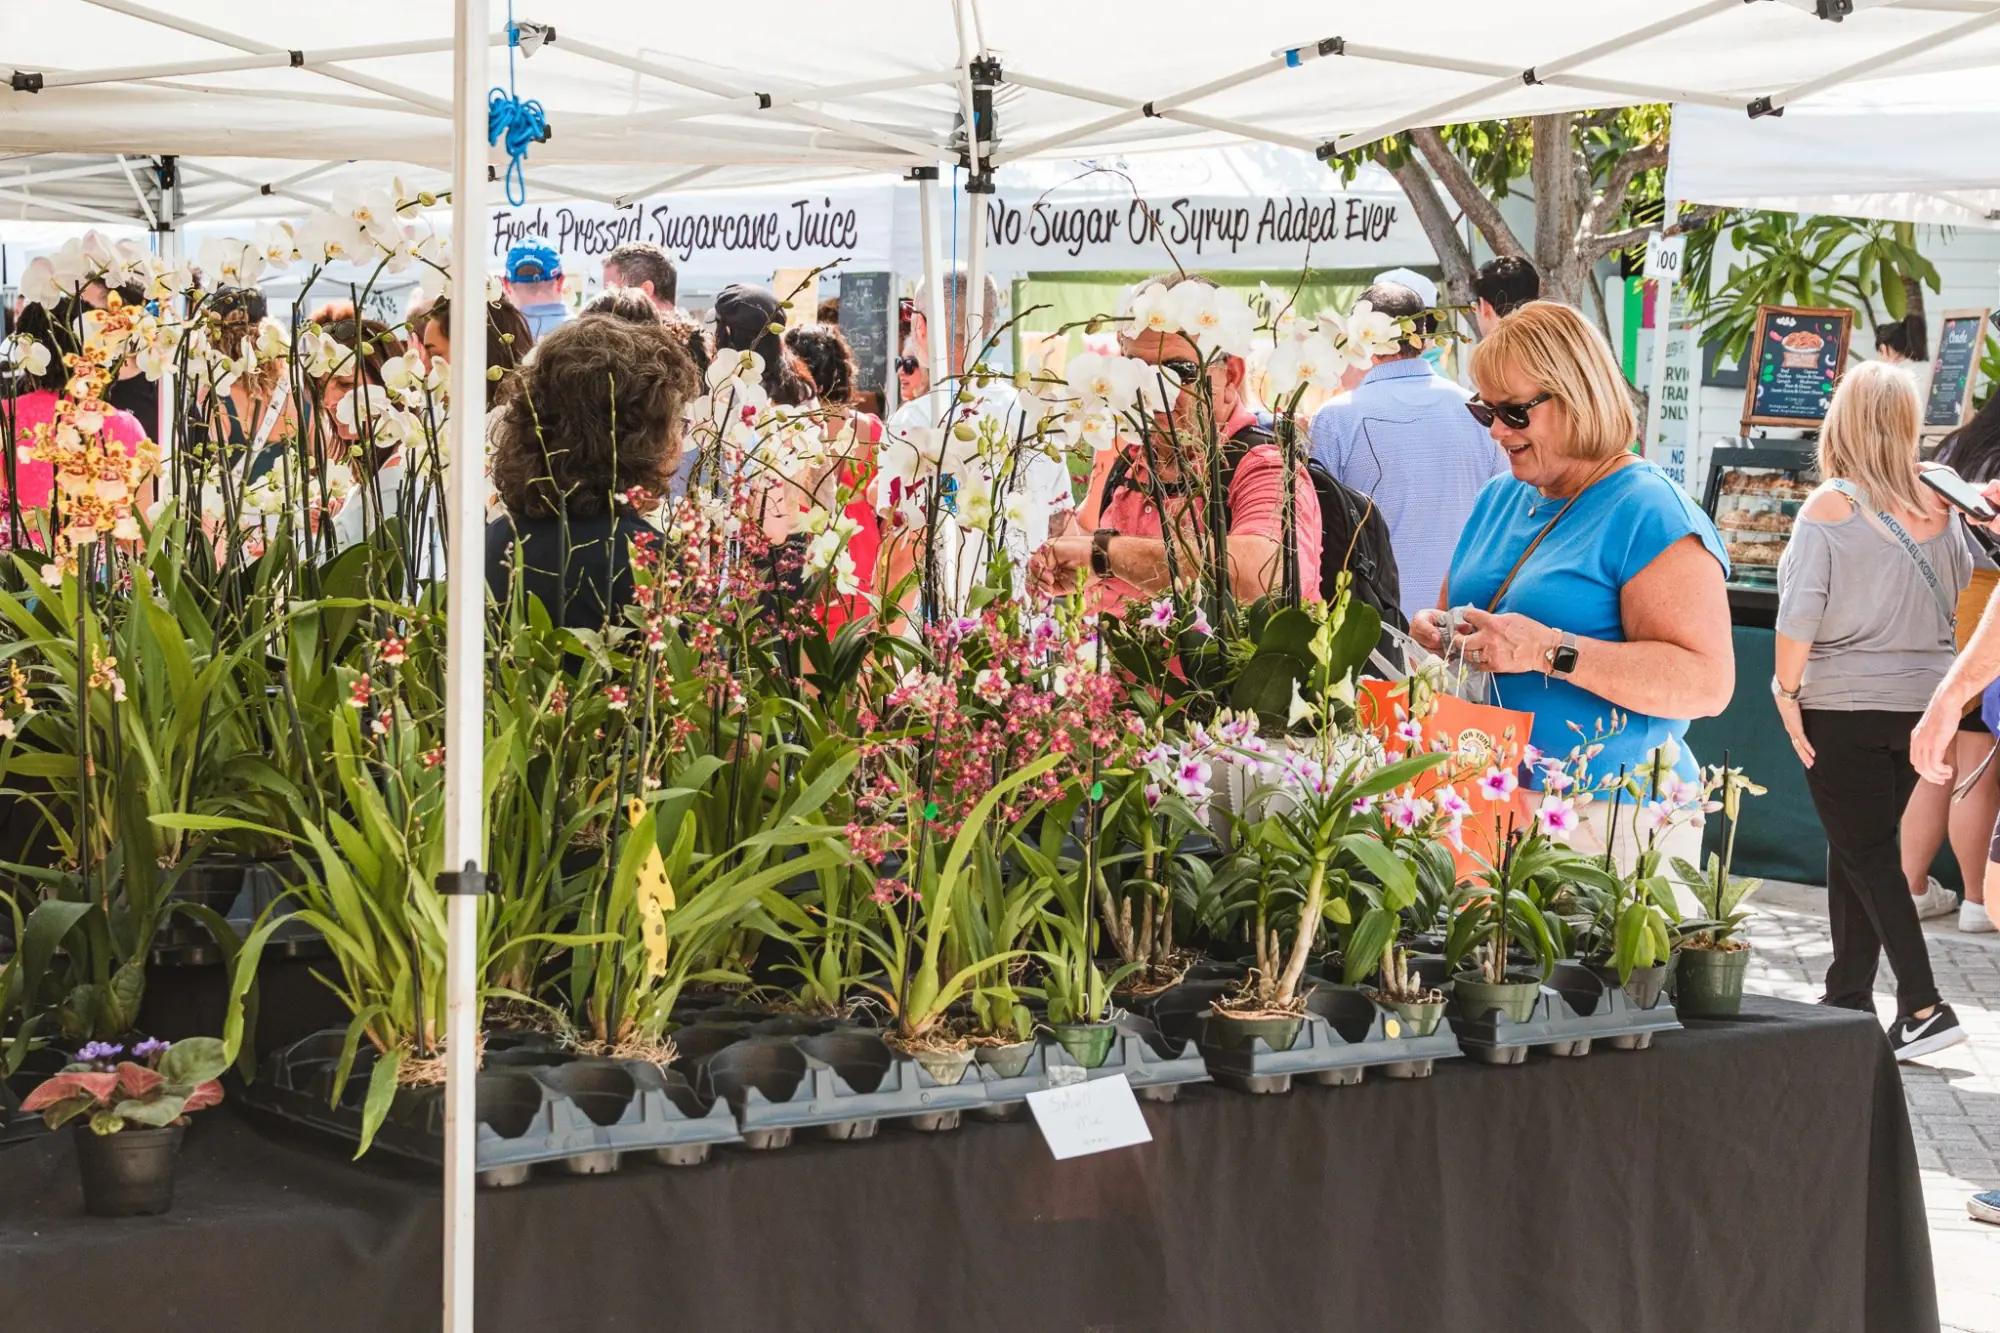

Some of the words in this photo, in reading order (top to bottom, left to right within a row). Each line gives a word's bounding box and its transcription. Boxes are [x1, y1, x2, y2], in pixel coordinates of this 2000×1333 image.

[493, 207, 549, 256] Fresh
[556, 204, 643, 255] Pressed
[649, 205, 780, 262] Sugarcane
[786, 197, 857, 250] Juice
[986, 198, 1021, 248] No
[1030, 202, 1121, 256] Sugar
[1128, 198, 1164, 245] Or
[1170, 198, 1249, 254] Syrup
[1256, 197, 1338, 244] Added
[1344, 198, 1398, 241] Ever
[1656, 250, 1677, 270] 100
[1671, 449, 1684, 464] NO
[1878, 511, 1919, 559] MICHAEL
[1918, 557, 1938, 588] KORS
